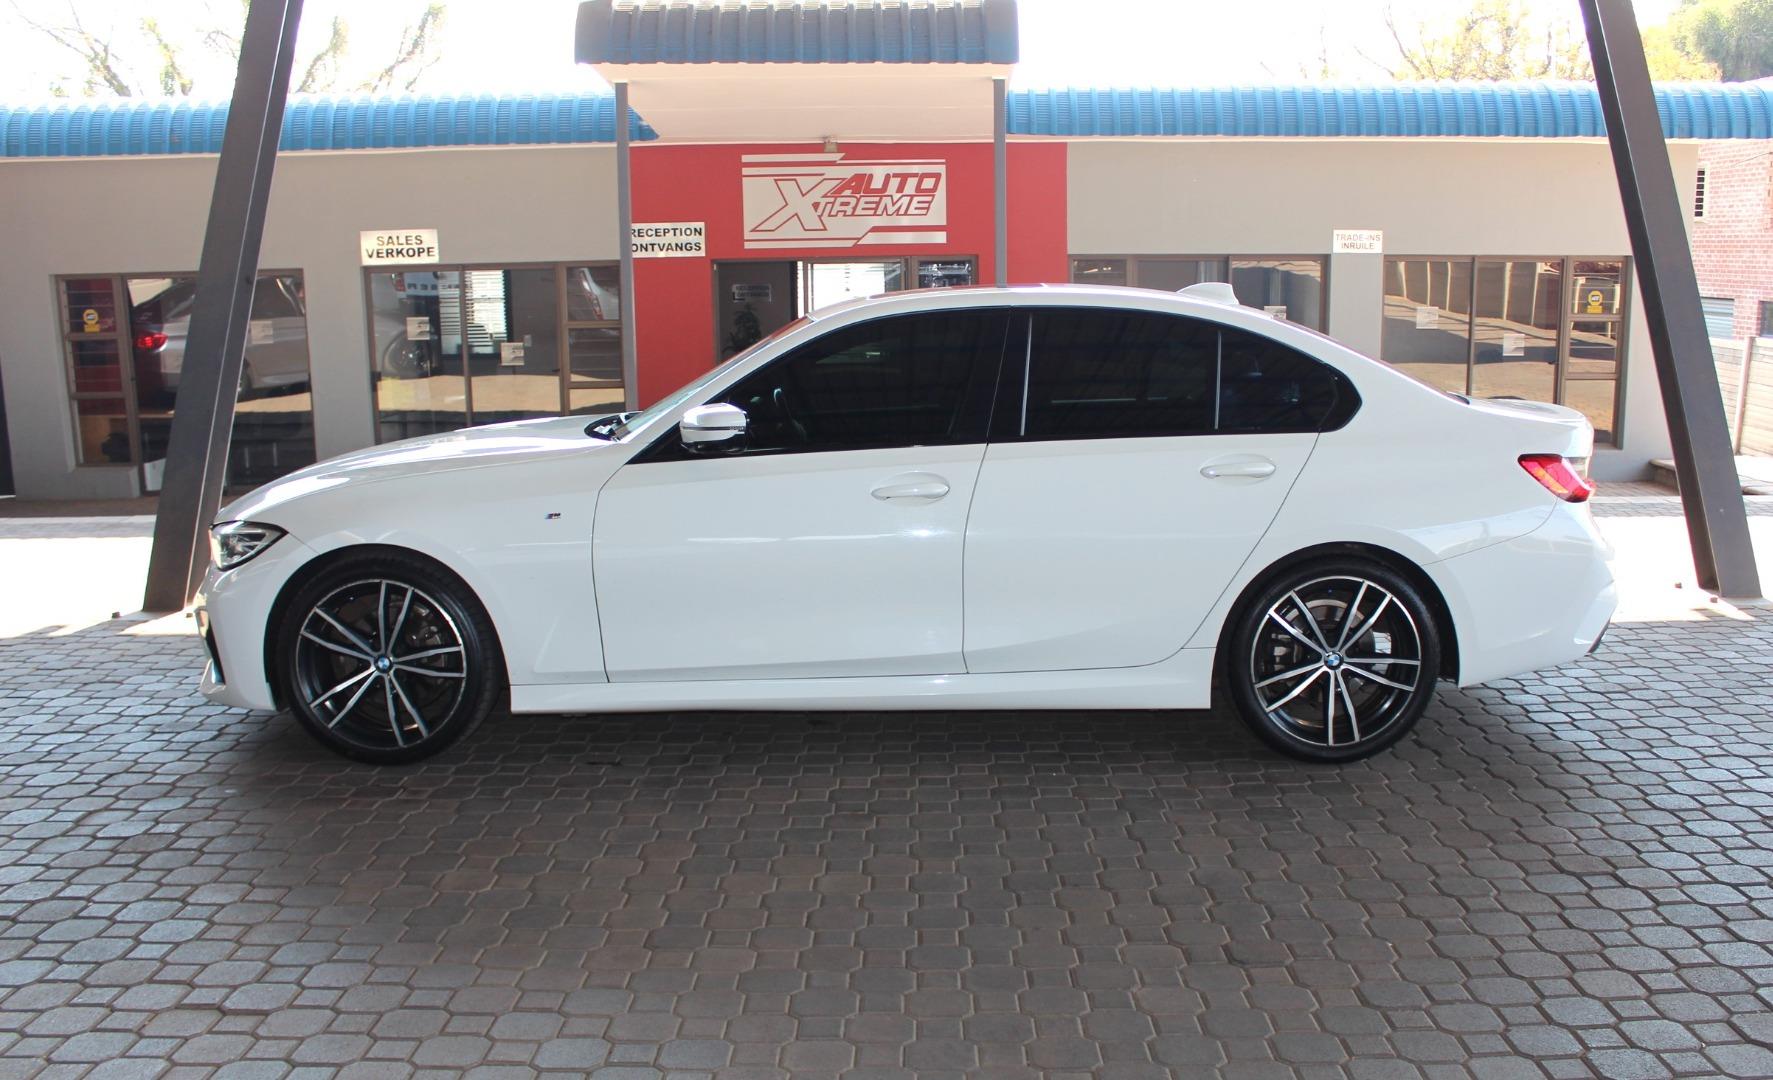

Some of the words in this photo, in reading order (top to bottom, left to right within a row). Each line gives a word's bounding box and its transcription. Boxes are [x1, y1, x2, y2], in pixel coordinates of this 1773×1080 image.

[828, 172, 942, 195] AUTO
[376, 235, 423, 246] SALES
[366, 247, 435, 258] VERKOPE
